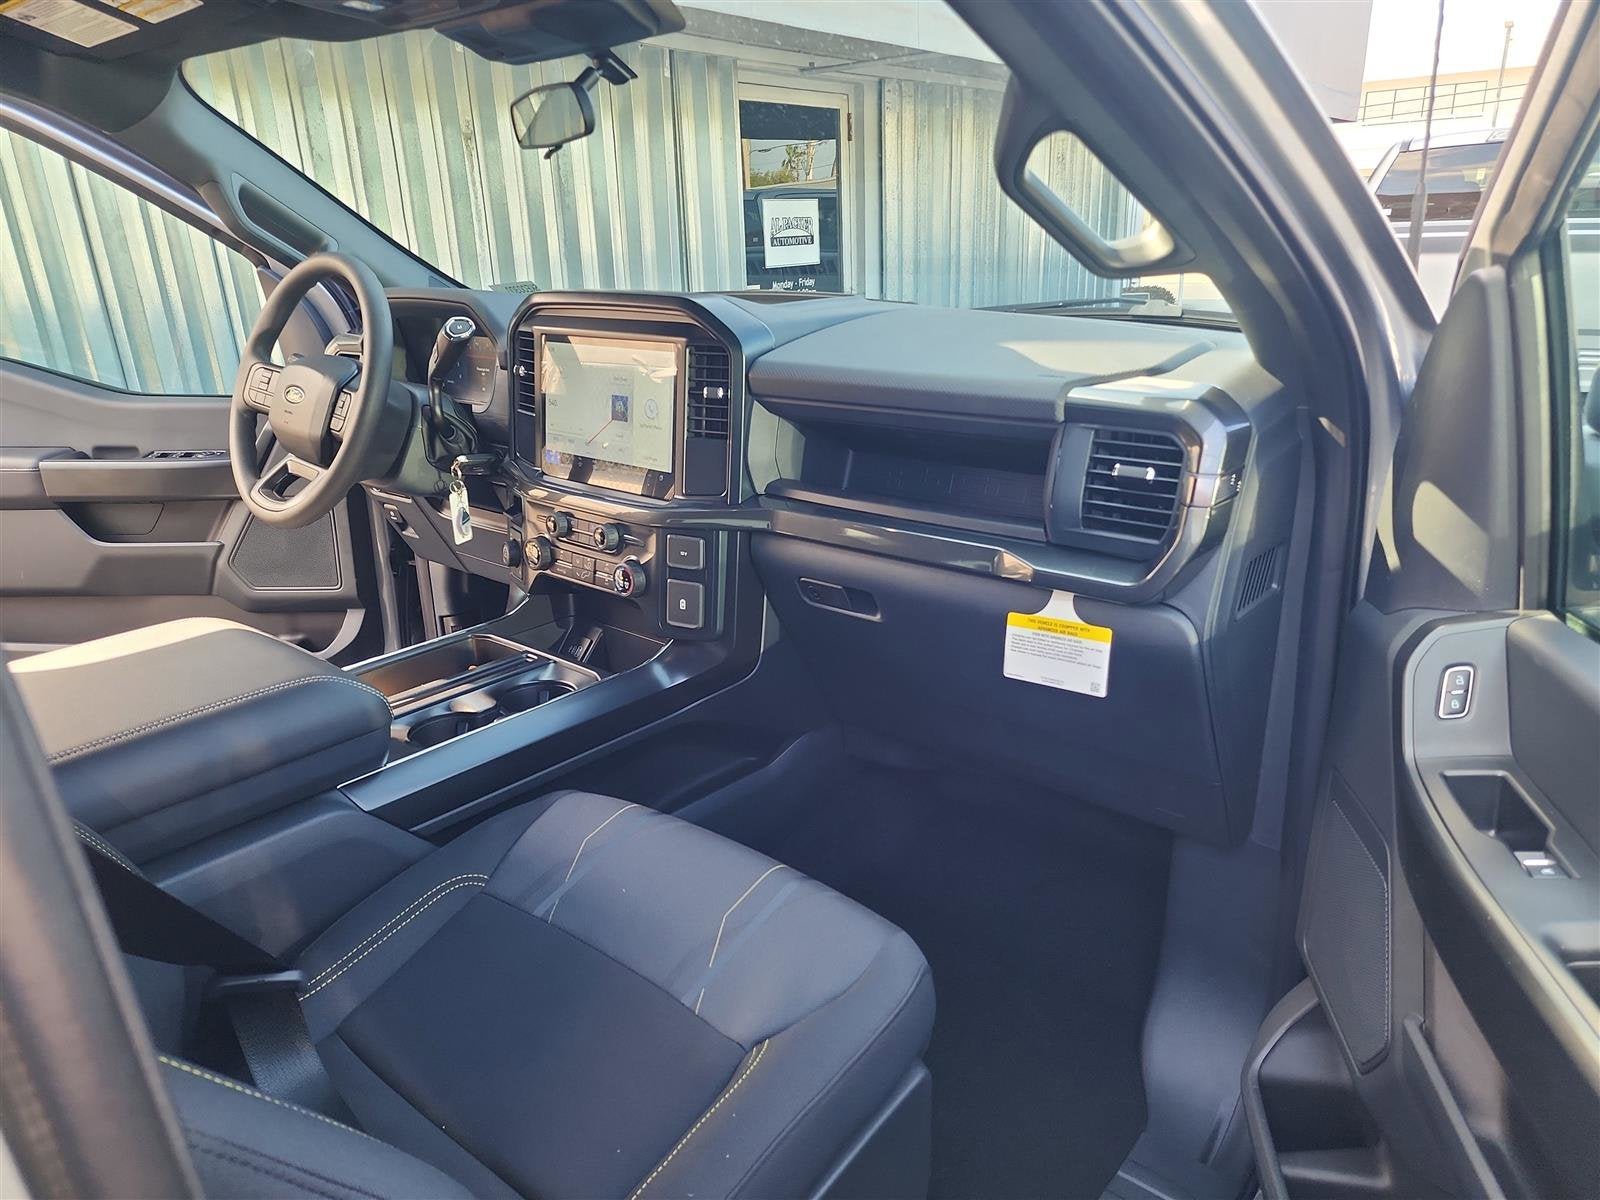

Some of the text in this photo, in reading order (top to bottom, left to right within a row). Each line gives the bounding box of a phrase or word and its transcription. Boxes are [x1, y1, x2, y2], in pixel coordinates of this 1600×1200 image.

[772, 236, 812, 246] AUTOMOTIVE
[772, 280, 794, 290] Monday
[799, 277, 816, 288] Friday
